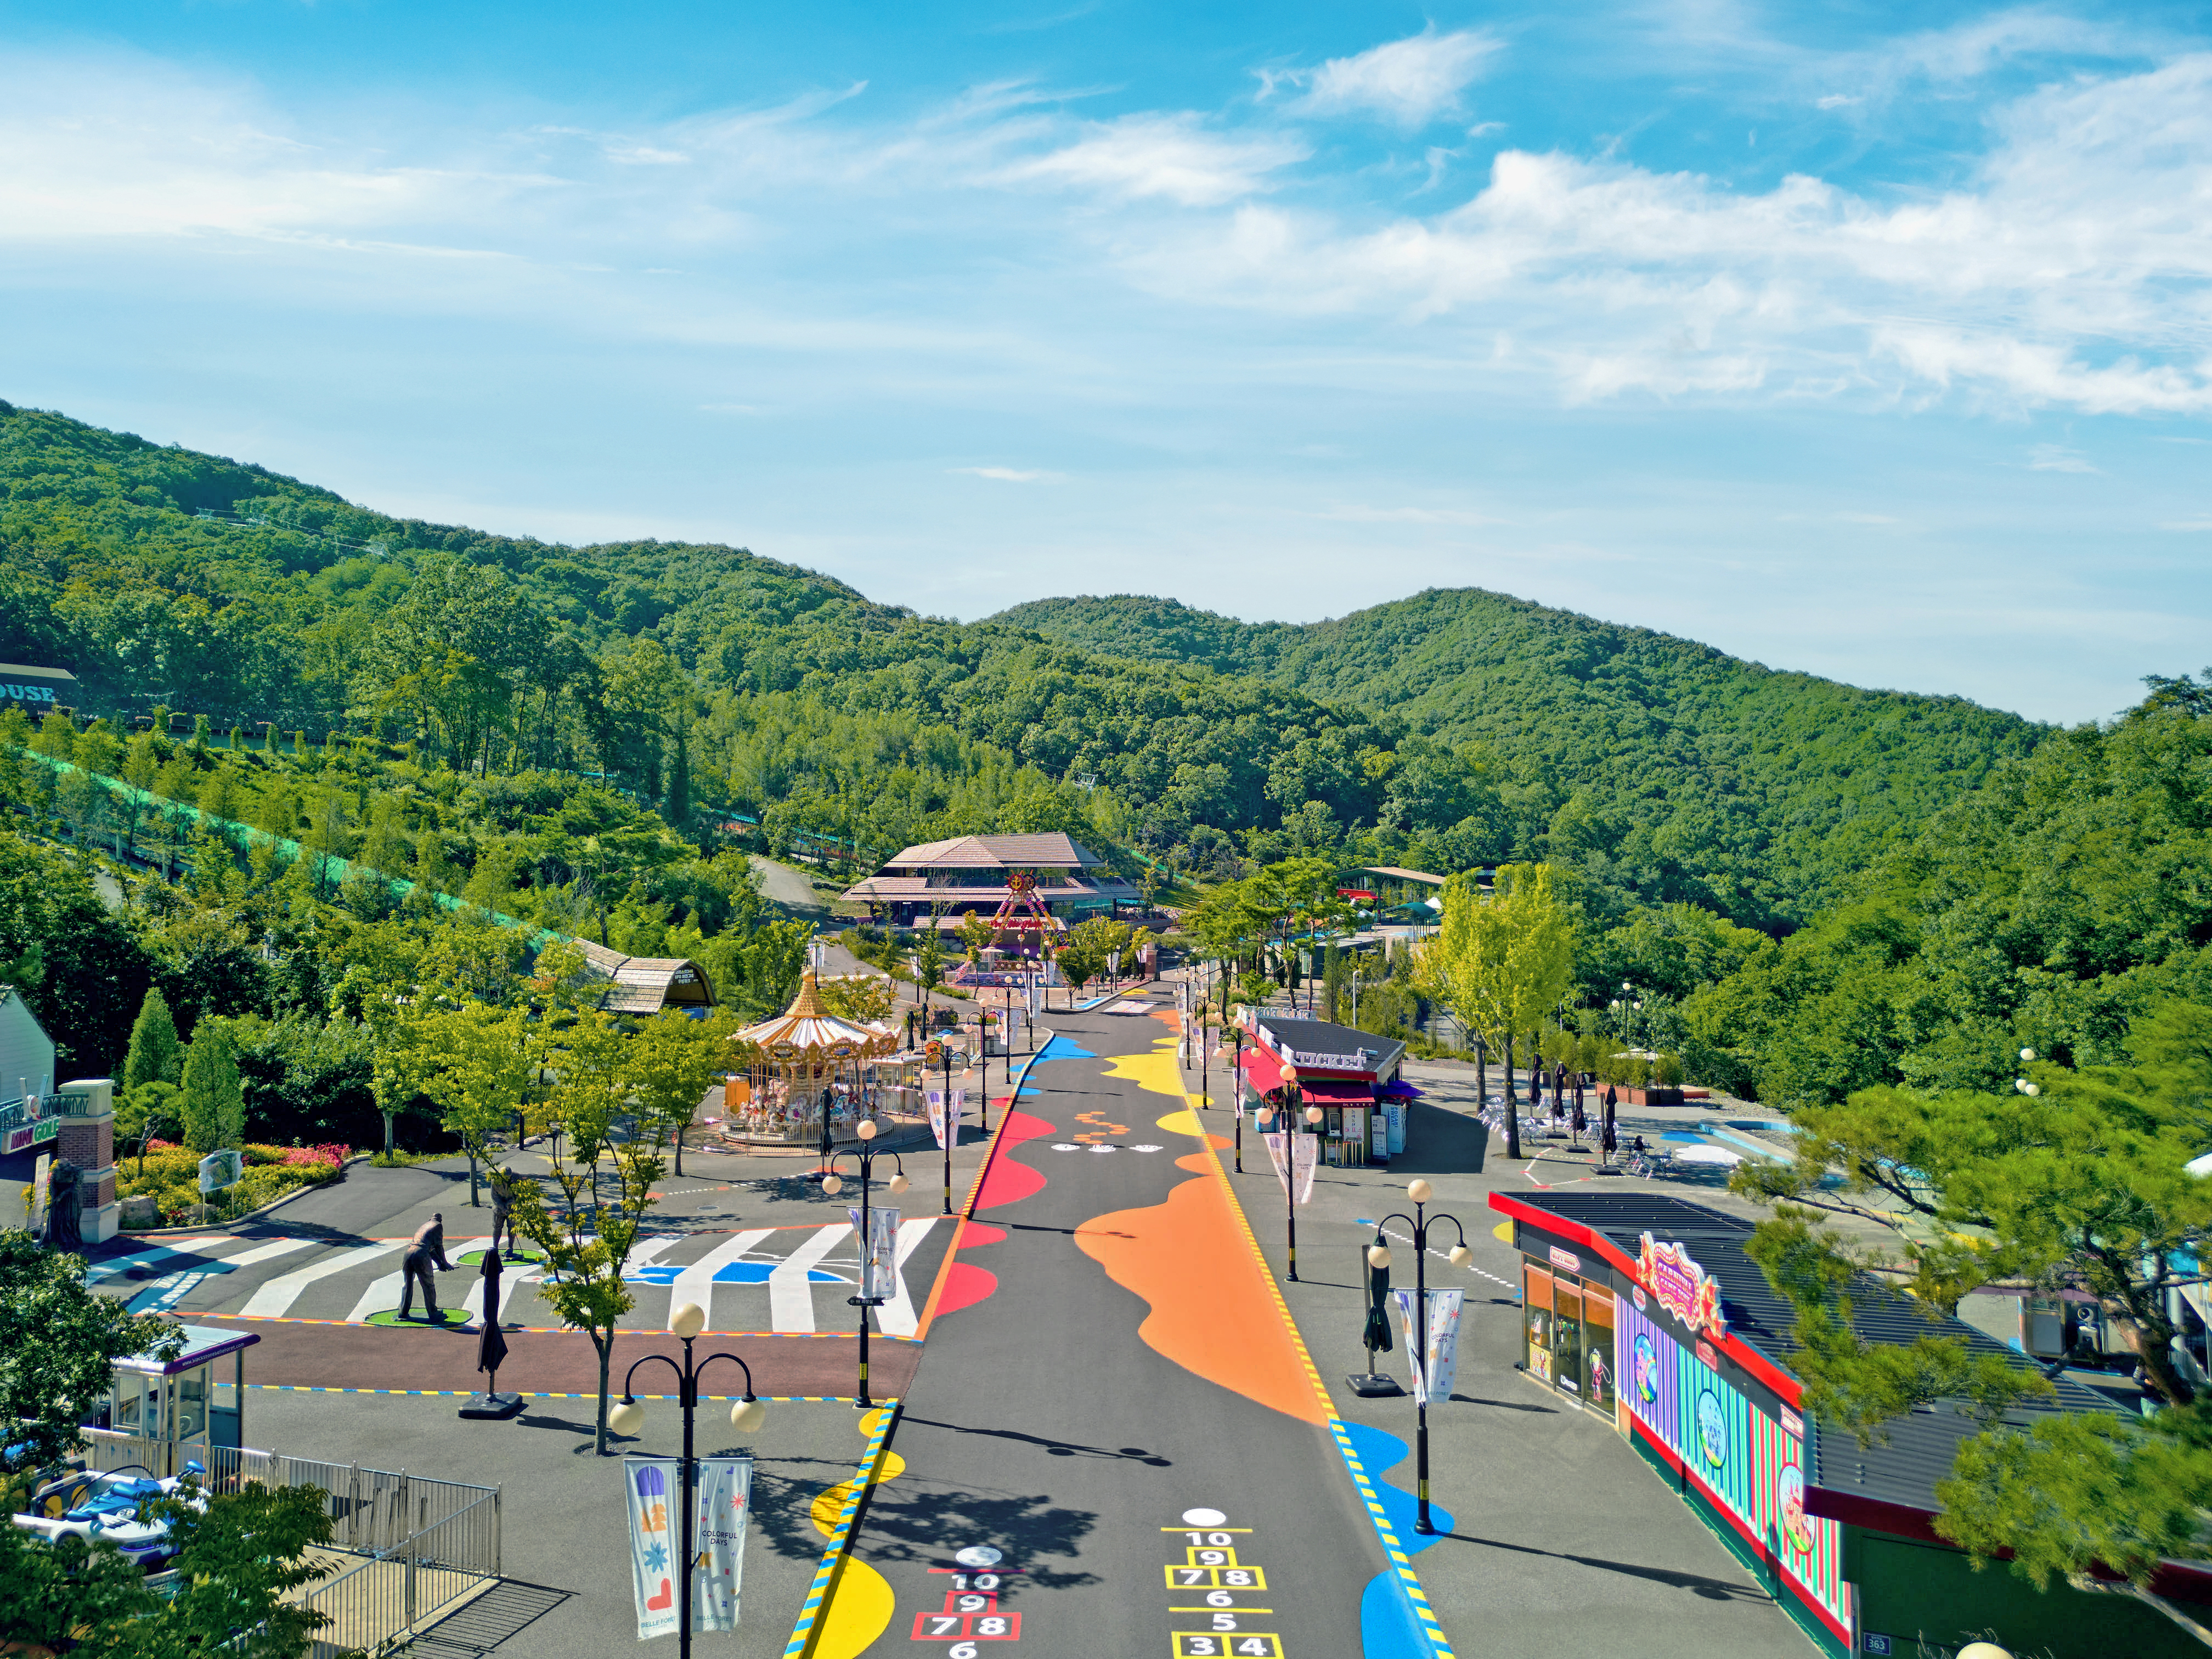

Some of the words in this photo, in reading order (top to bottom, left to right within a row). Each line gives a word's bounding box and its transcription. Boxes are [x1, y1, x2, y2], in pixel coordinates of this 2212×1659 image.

[1296, 1052, 1367, 1071] TICKET
[11, 1126, 33, 1150] MINI
[35, 1119, 59, 1142] GOLF
[1658, 1262, 1692, 1297] CARNIVAL
[702, 1530, 738, 1539] COLORFUL
[710, 1538, 727, 1546] DAYS
[1186, 1532, 1232, 1546] 10
[1200, 1551, 1224, 1565] 9
[951, 1574, 999, 1589] 10
[1180, 1570, 1203, 1584] 7
[1226, 1570, 1251, 1585] 8
[960, 1594, 985, 1611] 9
[1207, 1590, 1233, 1607] 6
[641, 1620, 661, 1628] BELLE
[931, 1617, 957, 1634] 7
[978, 1617, 1005, 1635] 8
[1212, 1613, 1237, 1630] 5
[949, 1641, 977, 1659] 6
[1189, 1637, 1215, 1655] 3
[1239, 1638, 1267, 1656] 4
[1869, 1638, 1886, 1650] 363
